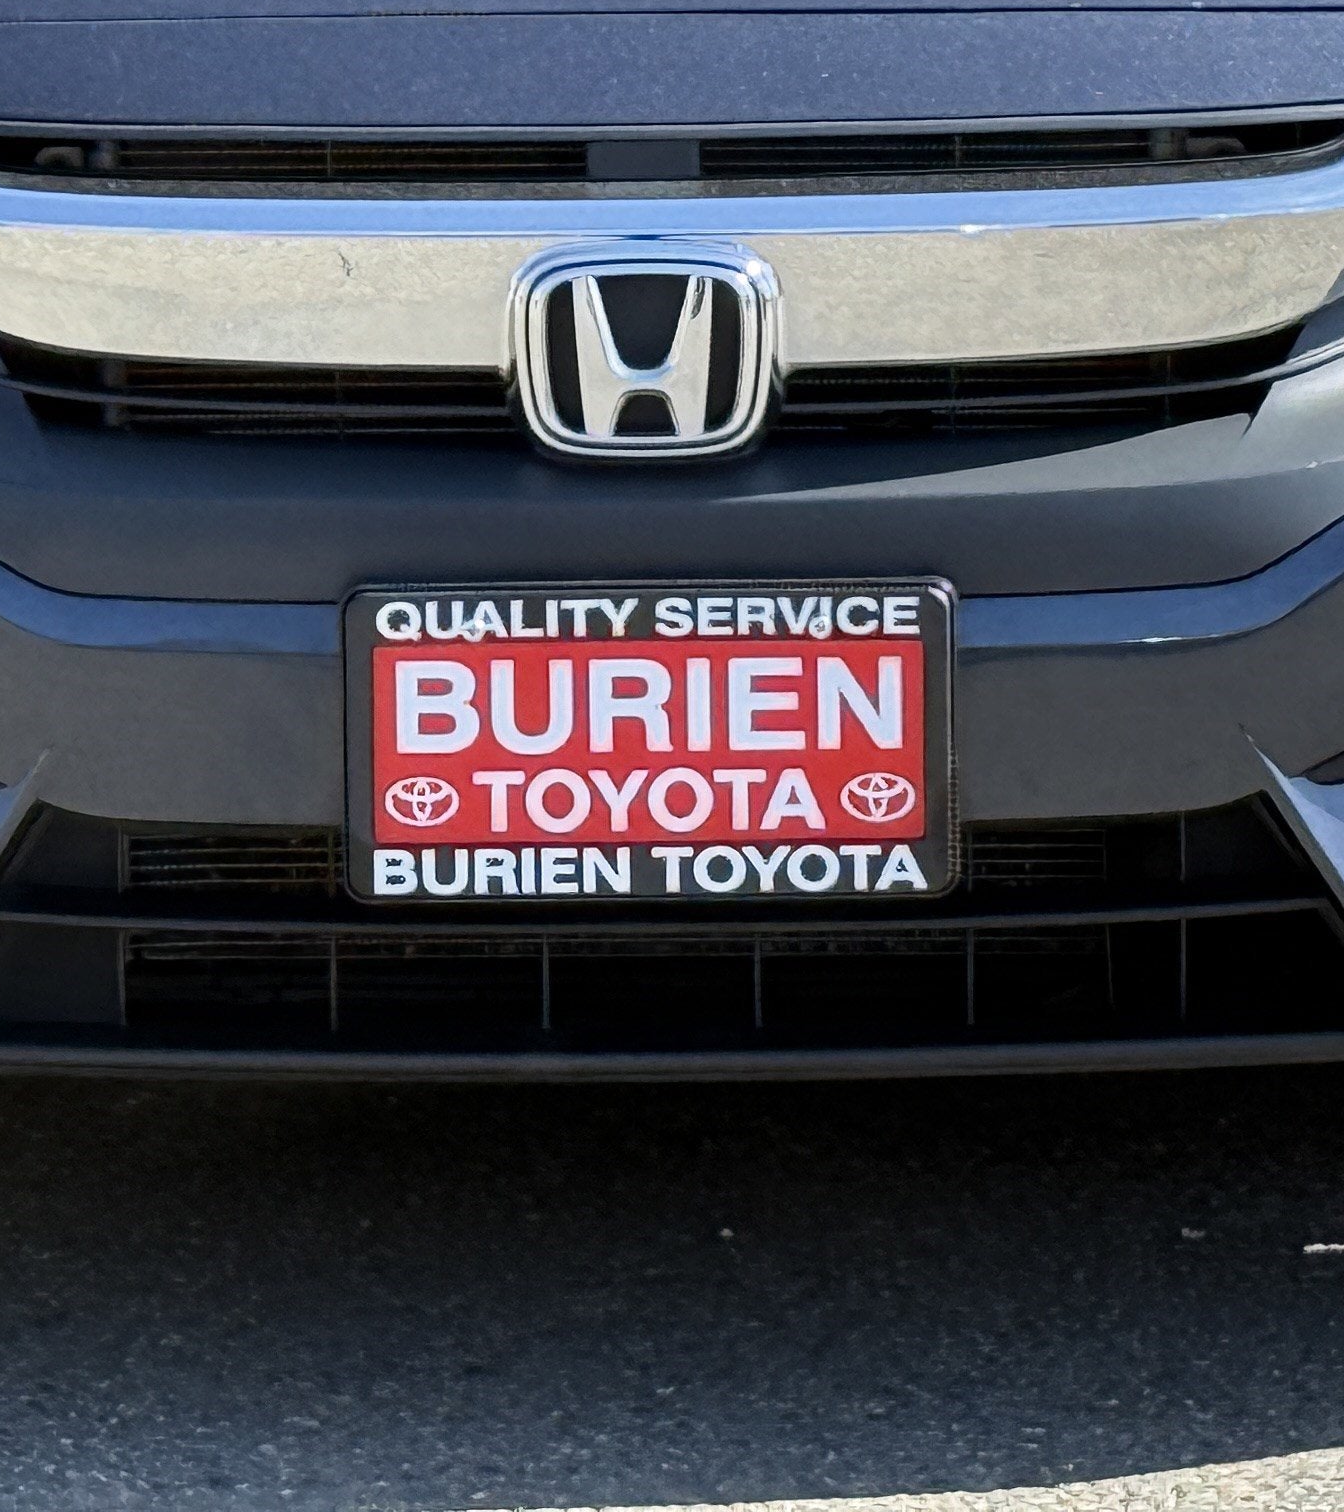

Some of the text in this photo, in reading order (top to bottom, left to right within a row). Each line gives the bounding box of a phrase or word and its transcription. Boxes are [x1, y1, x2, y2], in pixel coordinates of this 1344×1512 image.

[374, 596, 921, 642] QUALITY SERVICE
[393, 655, 904, 755] BURIEN
[471, 766, 827, 834] TOYOTA
[372, 843, 930, 895] BURIEN TOYOTA
